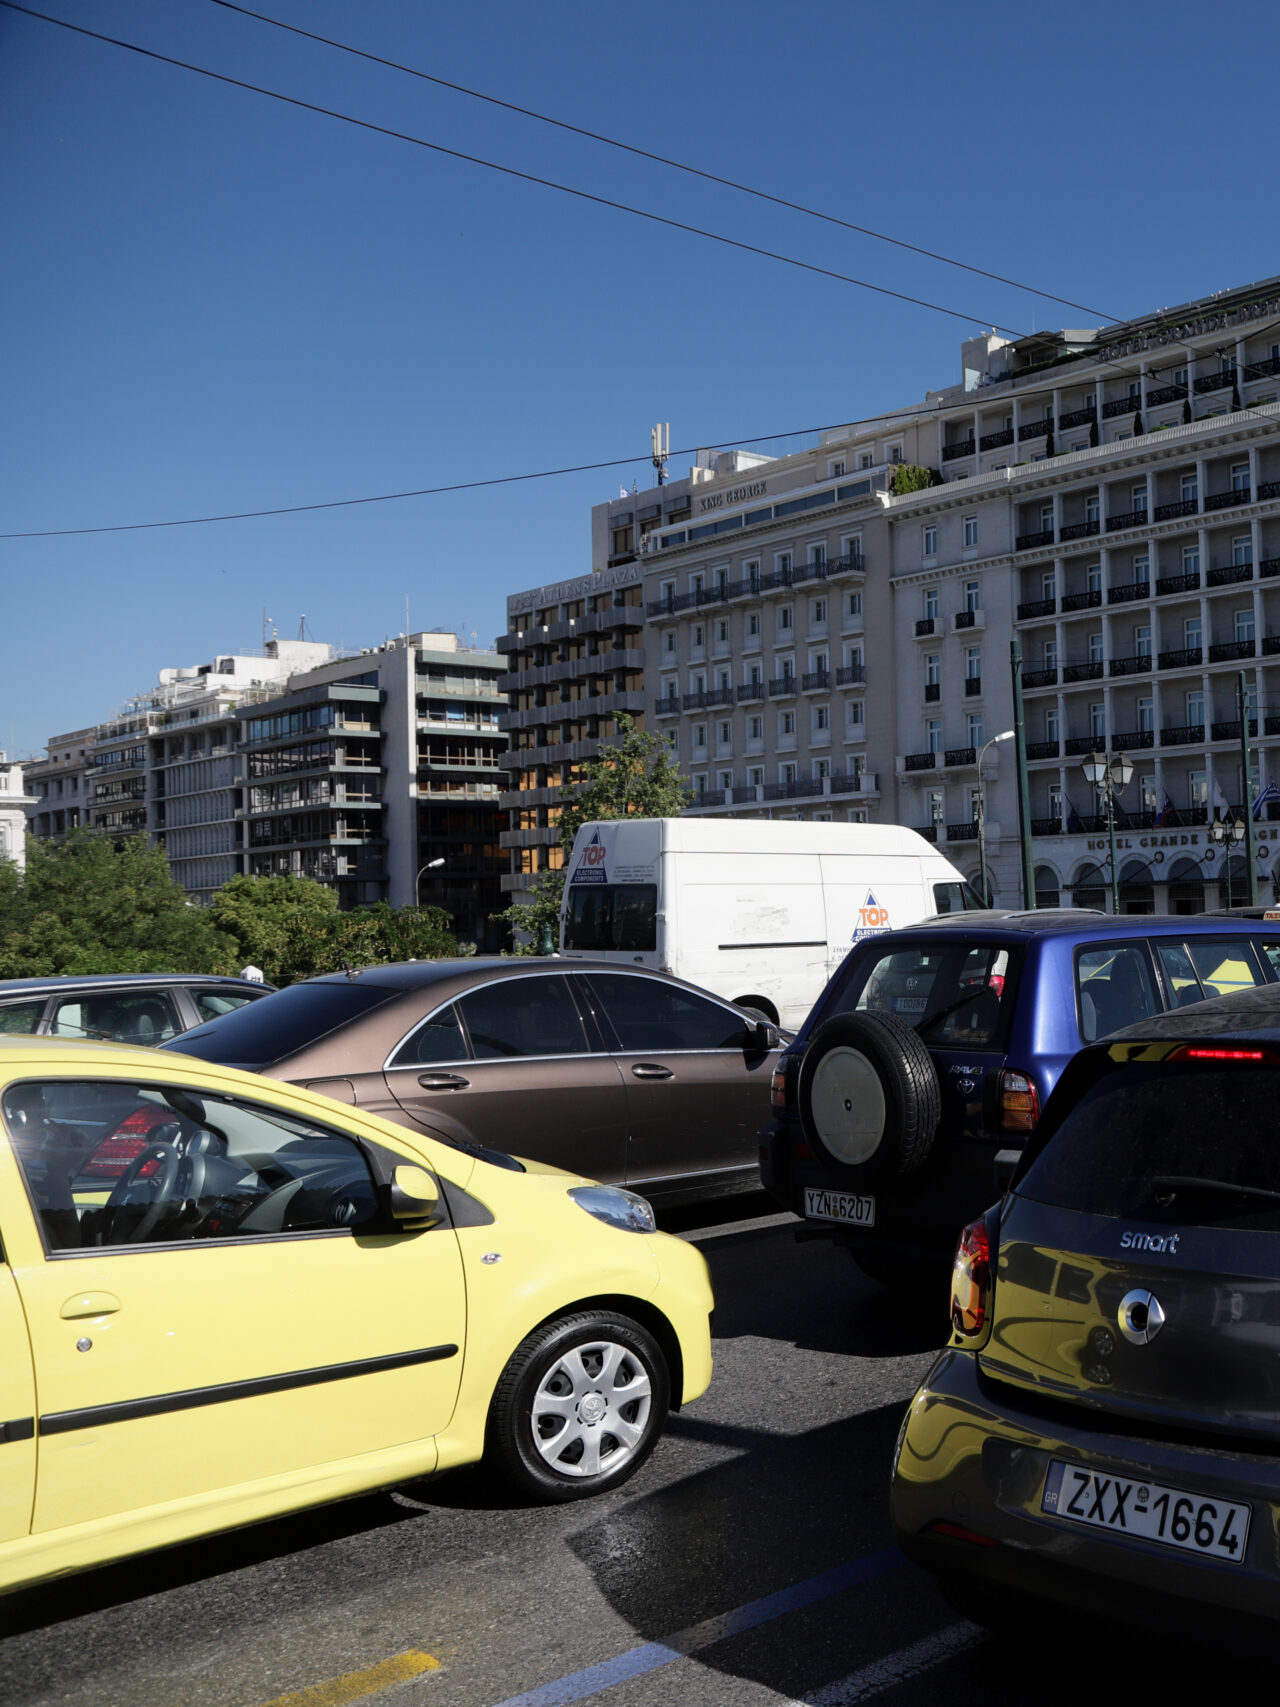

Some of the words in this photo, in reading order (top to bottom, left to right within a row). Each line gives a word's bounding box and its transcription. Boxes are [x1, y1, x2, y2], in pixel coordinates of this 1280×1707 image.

[700, 495, 723, 511] KING
[727, 481, 767, 504] GEORGE
[539, 581, 589, 605] ATHENS
[592, 567, 638, 591] PLAZA
[1140, 834, 1199, 848] GRANDE
[583, 846, 606, 866] TOP
[859, 907, 888, 926] TOP
[1120, 1231, 1180, 1254] smart
[1044, 1490, 1058, 1505] GR
